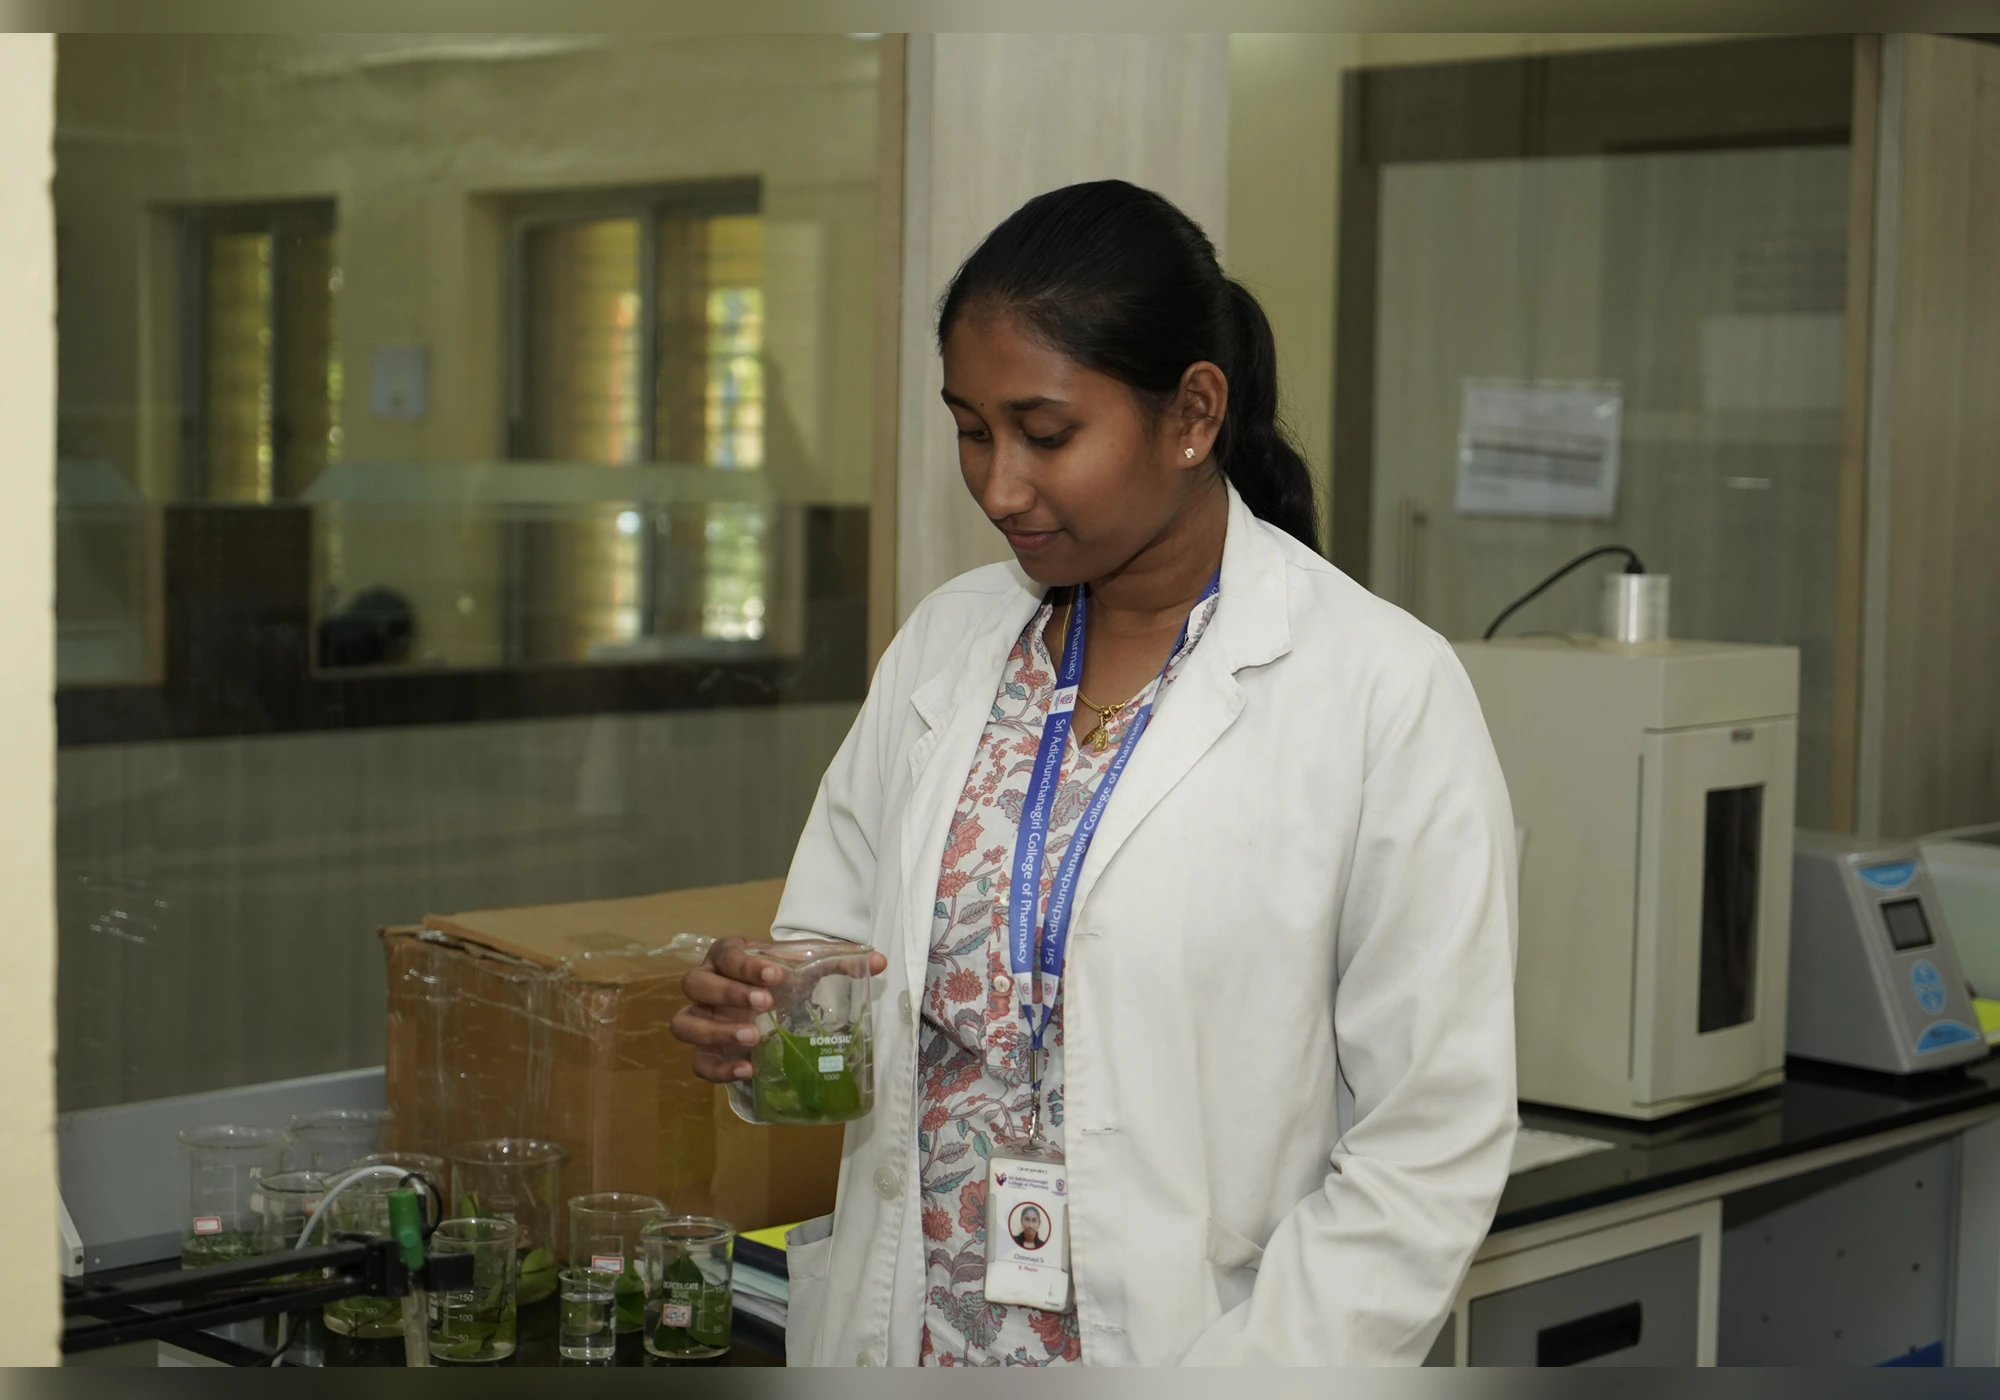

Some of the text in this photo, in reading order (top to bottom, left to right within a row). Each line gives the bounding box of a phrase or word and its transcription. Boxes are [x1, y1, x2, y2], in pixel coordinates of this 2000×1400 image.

[1066, 627, 1081, 680] Pharmacy
[1055, 718, 1066, 733] Sri
[1030, 735, 1062, 829] Adichunchanagiri
[1045, 713, 1144, 966] Sri Adichunchanagiri College of Pharmacy
[1021, 832, 1041, 880] College
[1022, 882, 1033, 898] of
[1017, 900, 1031, 964] Pharmacy
[810, 1035, 851, 1046] BOROSIL
[823, 1073, 840, 1081] 1000
[459, 1293, 474, 1302] 150
[459, 1314, 473, 1322] 100
